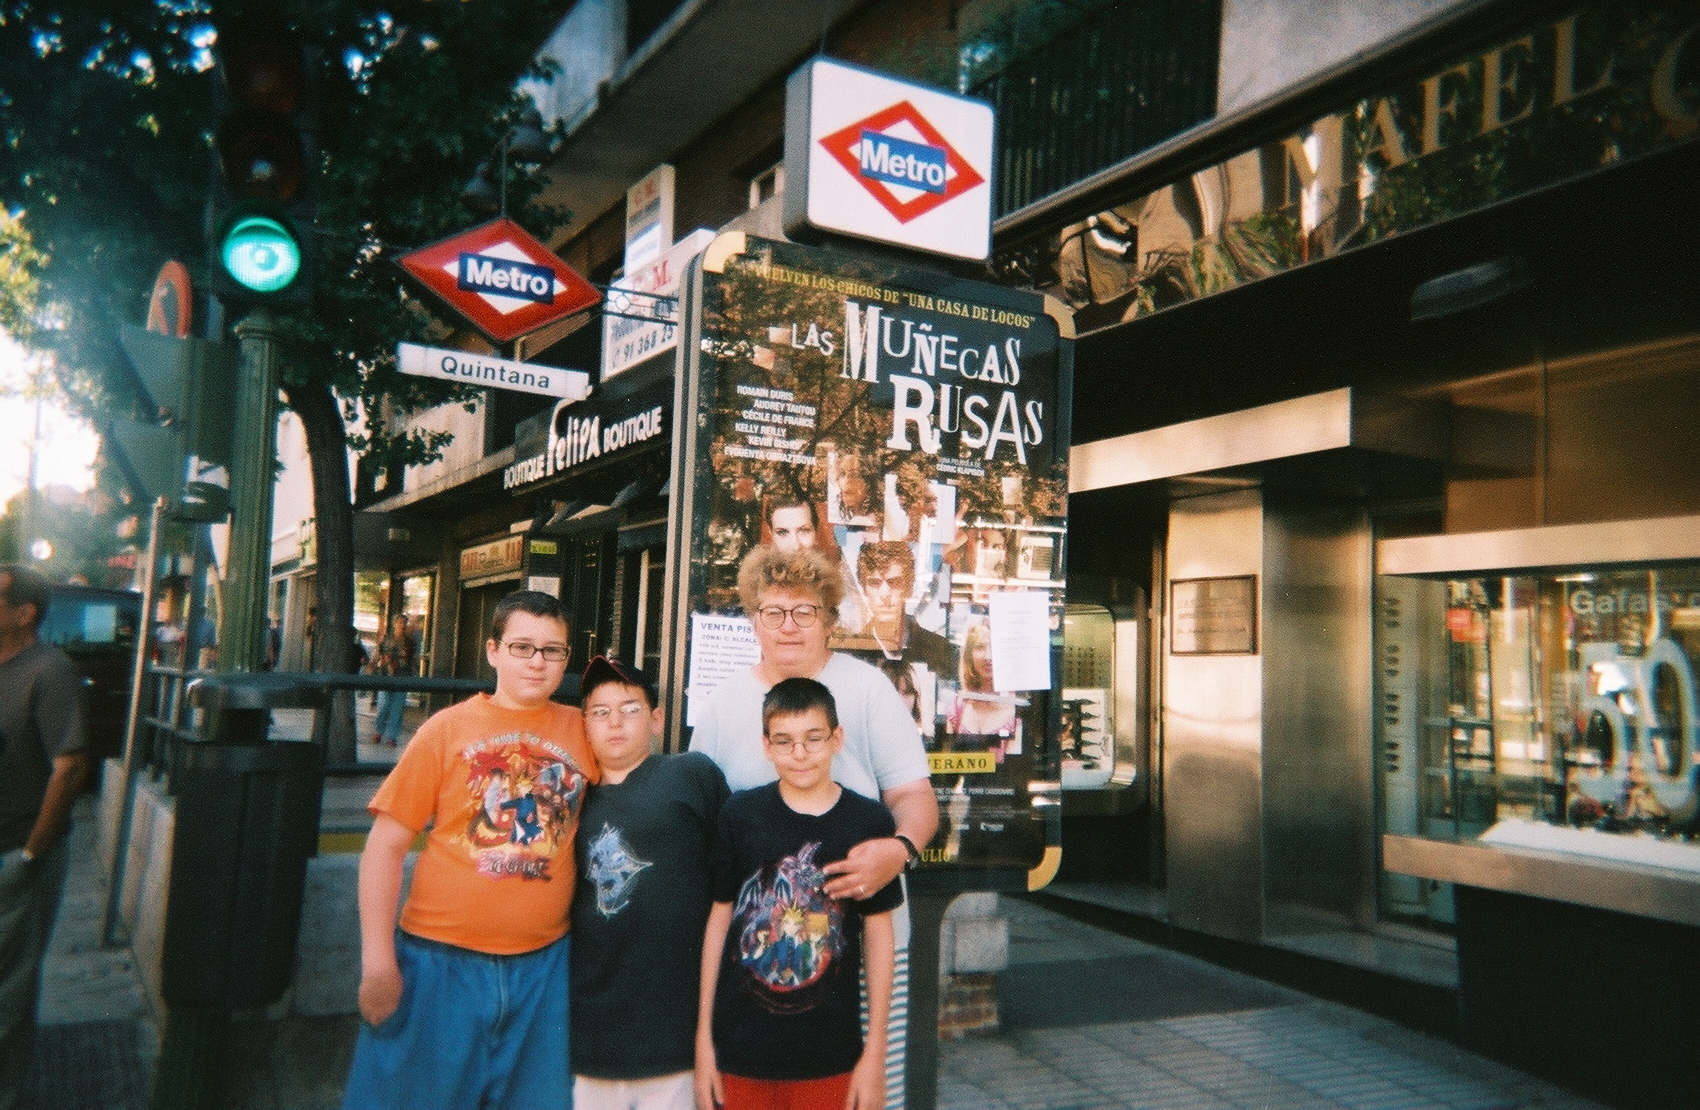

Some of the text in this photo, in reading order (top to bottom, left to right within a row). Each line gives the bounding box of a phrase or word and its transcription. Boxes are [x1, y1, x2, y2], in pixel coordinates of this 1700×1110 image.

[861, 138, 945, 187] Metro
[466, 257, 549, 296] Metro
[812, 274, 836, 292] LOS
[837, 280, 882, 301] CHICOS
[884, 290, 899, 304] DE
[936, 298, 970, 318] CASA
[972, 305, 989, 321] DE
[791, 299, 1022, 387] LAS MUÑECAS
[440, 355, 551, 390] Quintana
[735, 422, 759, 434] KELLY
[886, 373, 1043, 466] RUSAS
[504, 453, 547, 491] BOUTIQUE
[603, 405, 663, 453] BOUTIQUE
[701, 622, 734, 632] VENTA
[928, 758, 988, 770] ERANO
[921, 849, 951, 863] ULIO
